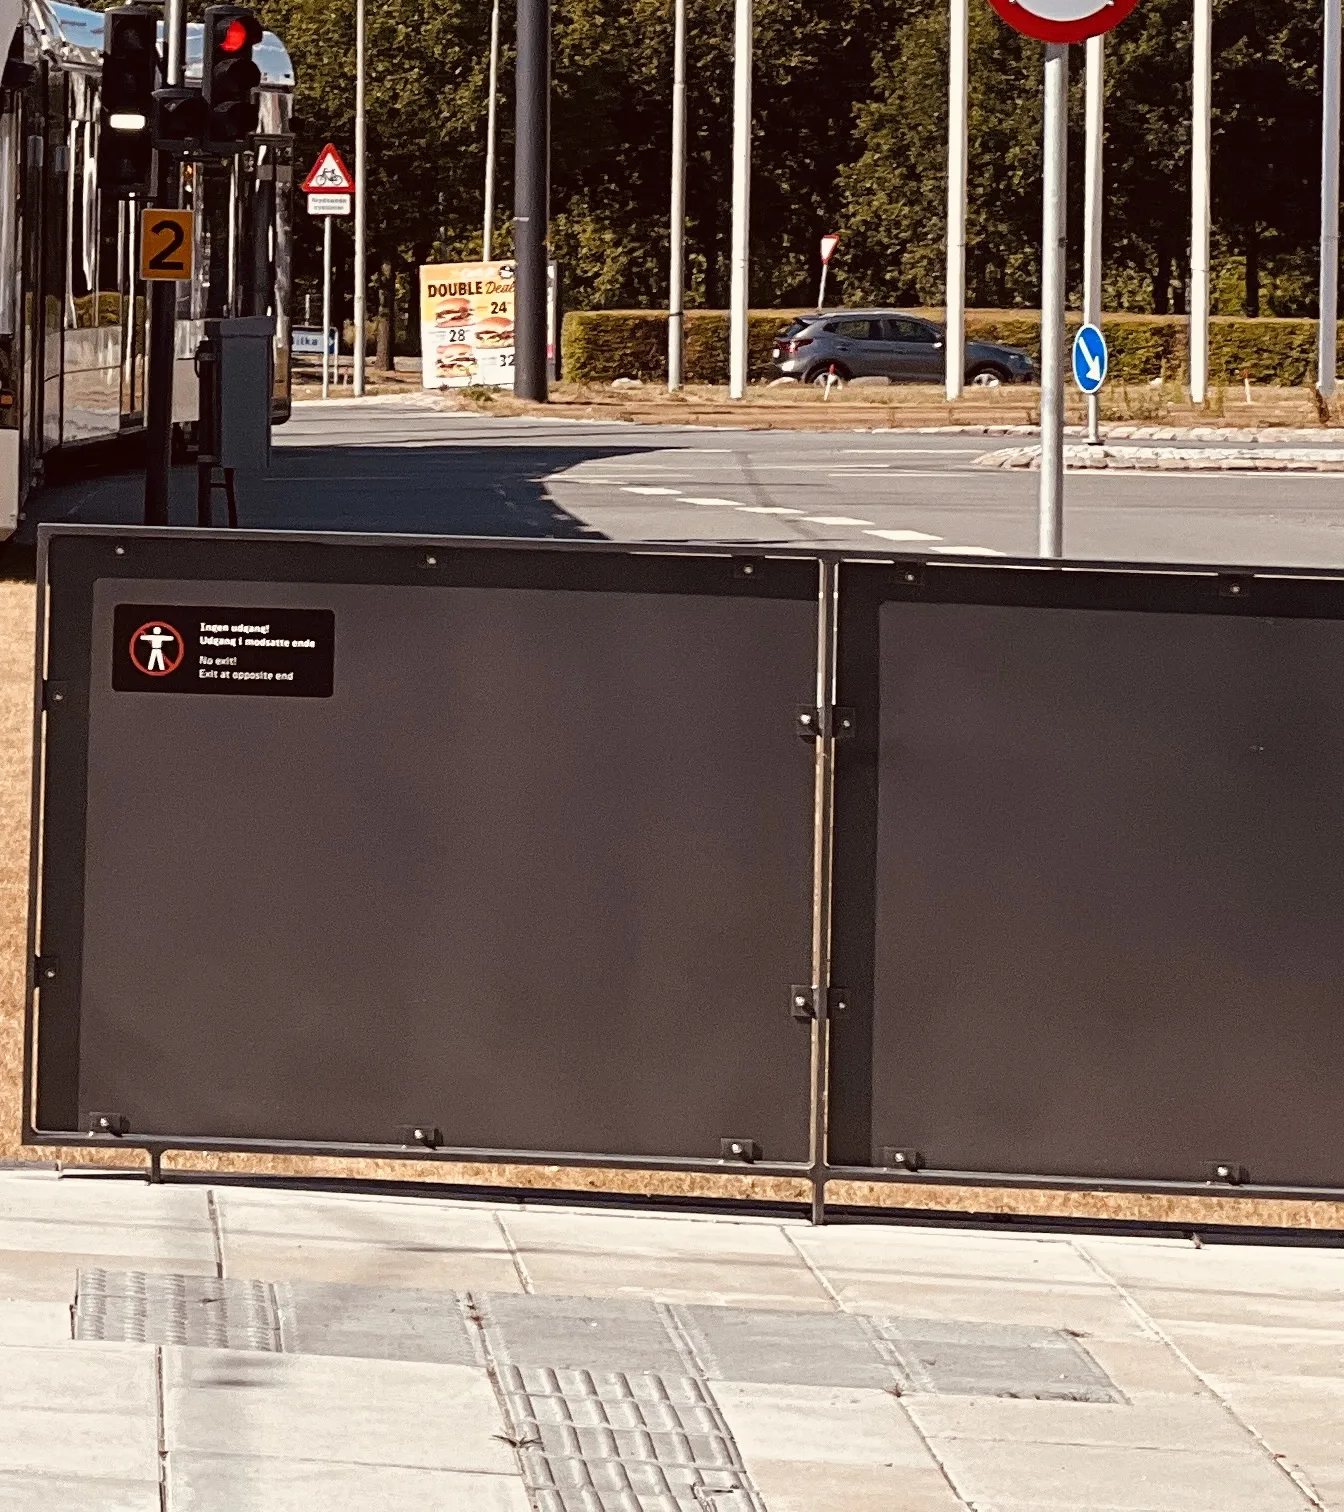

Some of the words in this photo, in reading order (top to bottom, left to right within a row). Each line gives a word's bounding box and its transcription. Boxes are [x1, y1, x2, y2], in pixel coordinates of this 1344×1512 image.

[149, 219, 185, 270] 2
[427, 281, 483, 298] DOUBLE
[490, 301, 508, 315] 24
[291, 336, 318, 346] ilka
[449, 329, 466, 343] 28
[200, 622, 229, 633] Ingen
[231, 623, 270, 634] udgang!
[200, 635, 236, 647] Udgang
[244, 637, 290, 647] modsatte
[292, 639, 316, 648] ende
[199, 655, 213, 665] No
[215, 656, 238, 666] exit!
[199, 668, 218, 678] Exit
[220, 670, 231, 679] at
[232, 671, 274, 680] opposite
[275, 672, 294, 680] end
